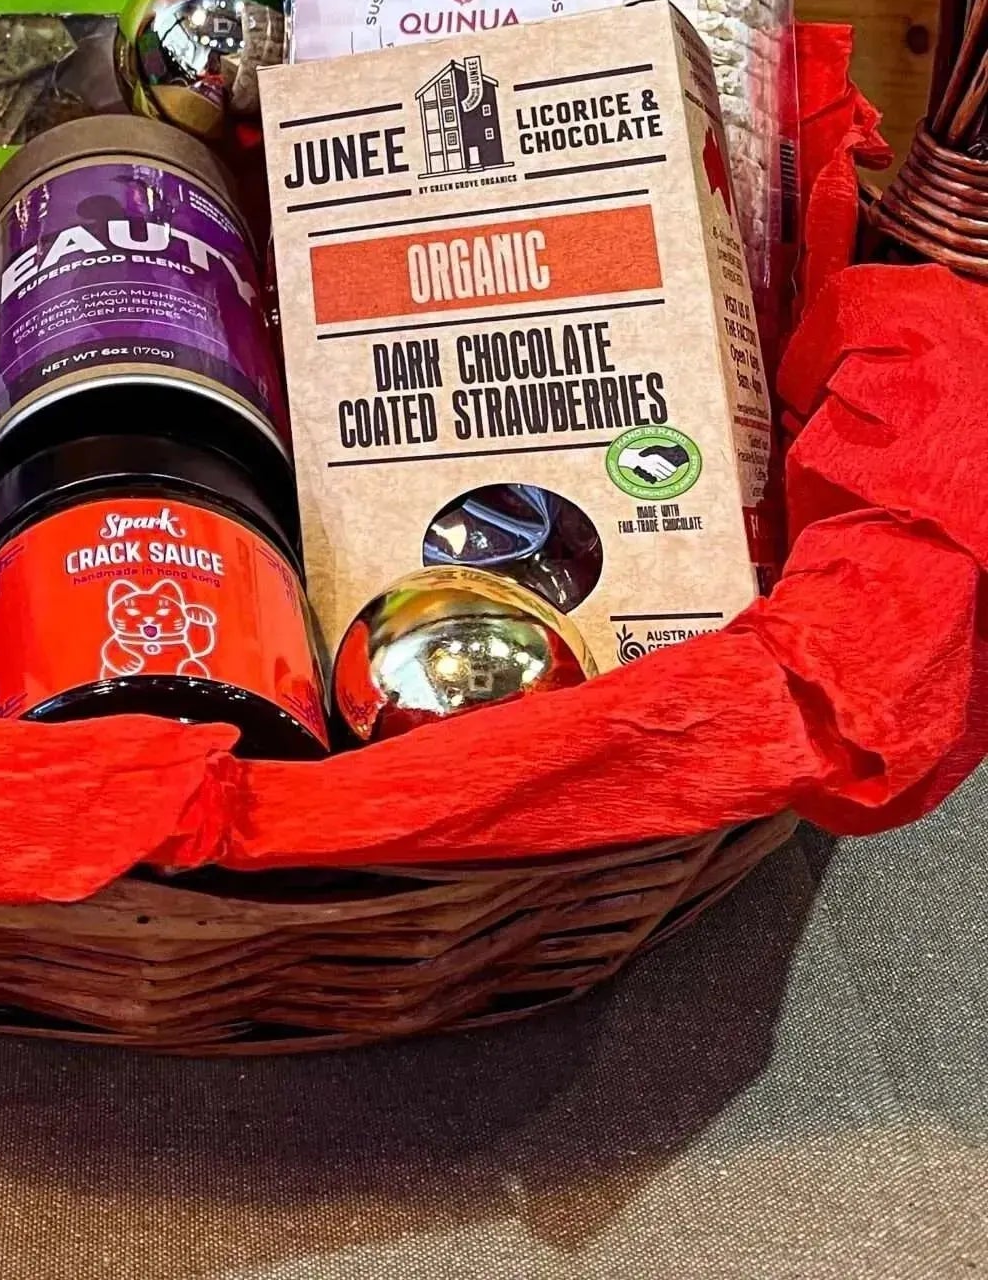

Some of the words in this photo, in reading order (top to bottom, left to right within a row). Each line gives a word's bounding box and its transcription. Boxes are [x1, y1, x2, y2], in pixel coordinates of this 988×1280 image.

[399, 8, 520, 35] QUINUA
[516, 93, 629, 131] LICORICE
[641, 89, 659, 111] &
[519, 114, 663, 156] CHOCOLATE
[284, 127, 410, 189] JUNEE
[430, 183, 452, 193] GREEN
[455, 180, 478, 189] GROVE
[481, 175, 517, 186] ORGANICS
[17, 254, 126, 300] SUPERFOOD
[131, 254, 195, 275] BLEND
[406, 229, 550, 305] ORGANIC
[82, 289, 127, 301] CHAGA
[130, 289, 207, 313] MUSHROOM
[84, 298, 128, 309] MAQUI
[47, 308, 114, 331] COLLAGEN
[119, 306, 181, 320] PEPTIDES
[41, 358, 69, 375] NET
[73, 350, 98, 362] WT
[101, 347, 129, 356] 6oz
[133, 346, 174, 360] (170g)
[373, 338, 443, 392] DARK
[457, 321, 616, 385] CHOCOLATE
[339, 388, 437, 449] COATED
[453, 372, 668, 440] STRAWBERRIES
[99, 508, 186, 539] Spark
[661, 504, 680, 517] WITH
[662, 516, 703, 531] CHOCOLATE
[66, 541, 143, 574] CRACK
[148, 542, 225, 576] SAUCE
[74, 568, 138, 585] handmade
[142, 566, 154, 575] in
[157, 567, 188, 579] hong
[192, 574, 221, 588] kong
